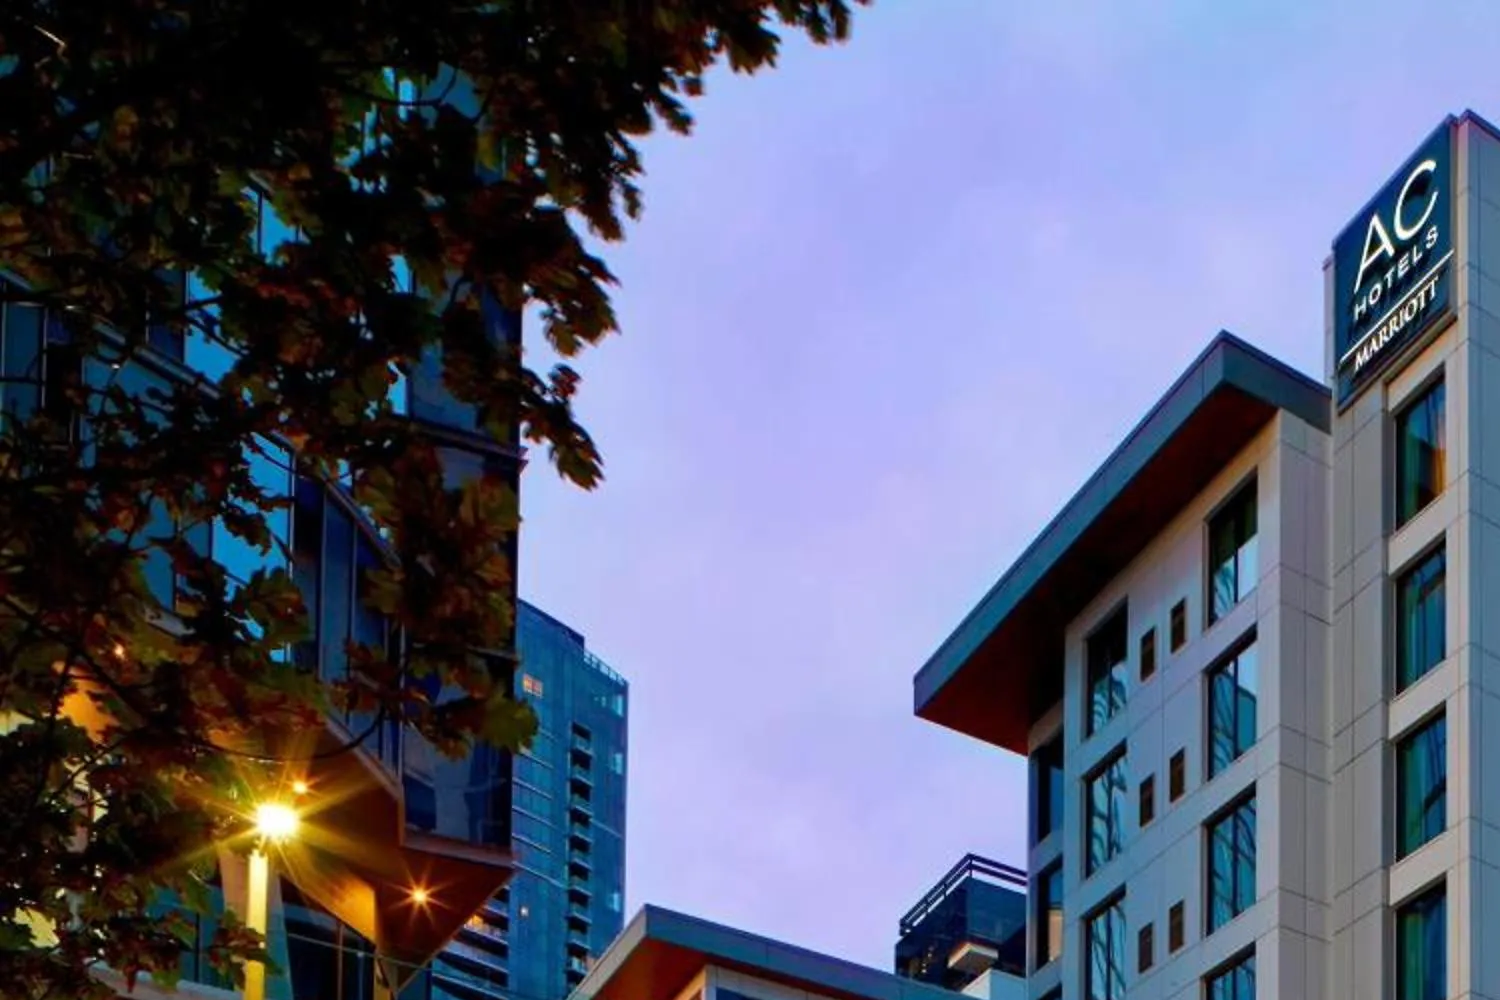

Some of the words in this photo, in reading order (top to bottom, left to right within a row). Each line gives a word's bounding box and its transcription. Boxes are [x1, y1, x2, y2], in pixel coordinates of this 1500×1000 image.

[1353, 225, 1439, 322] HOTELS
[1354, 159, 1438, 294] AC
[1354, 276, 1440, 373] MARRIOTT
